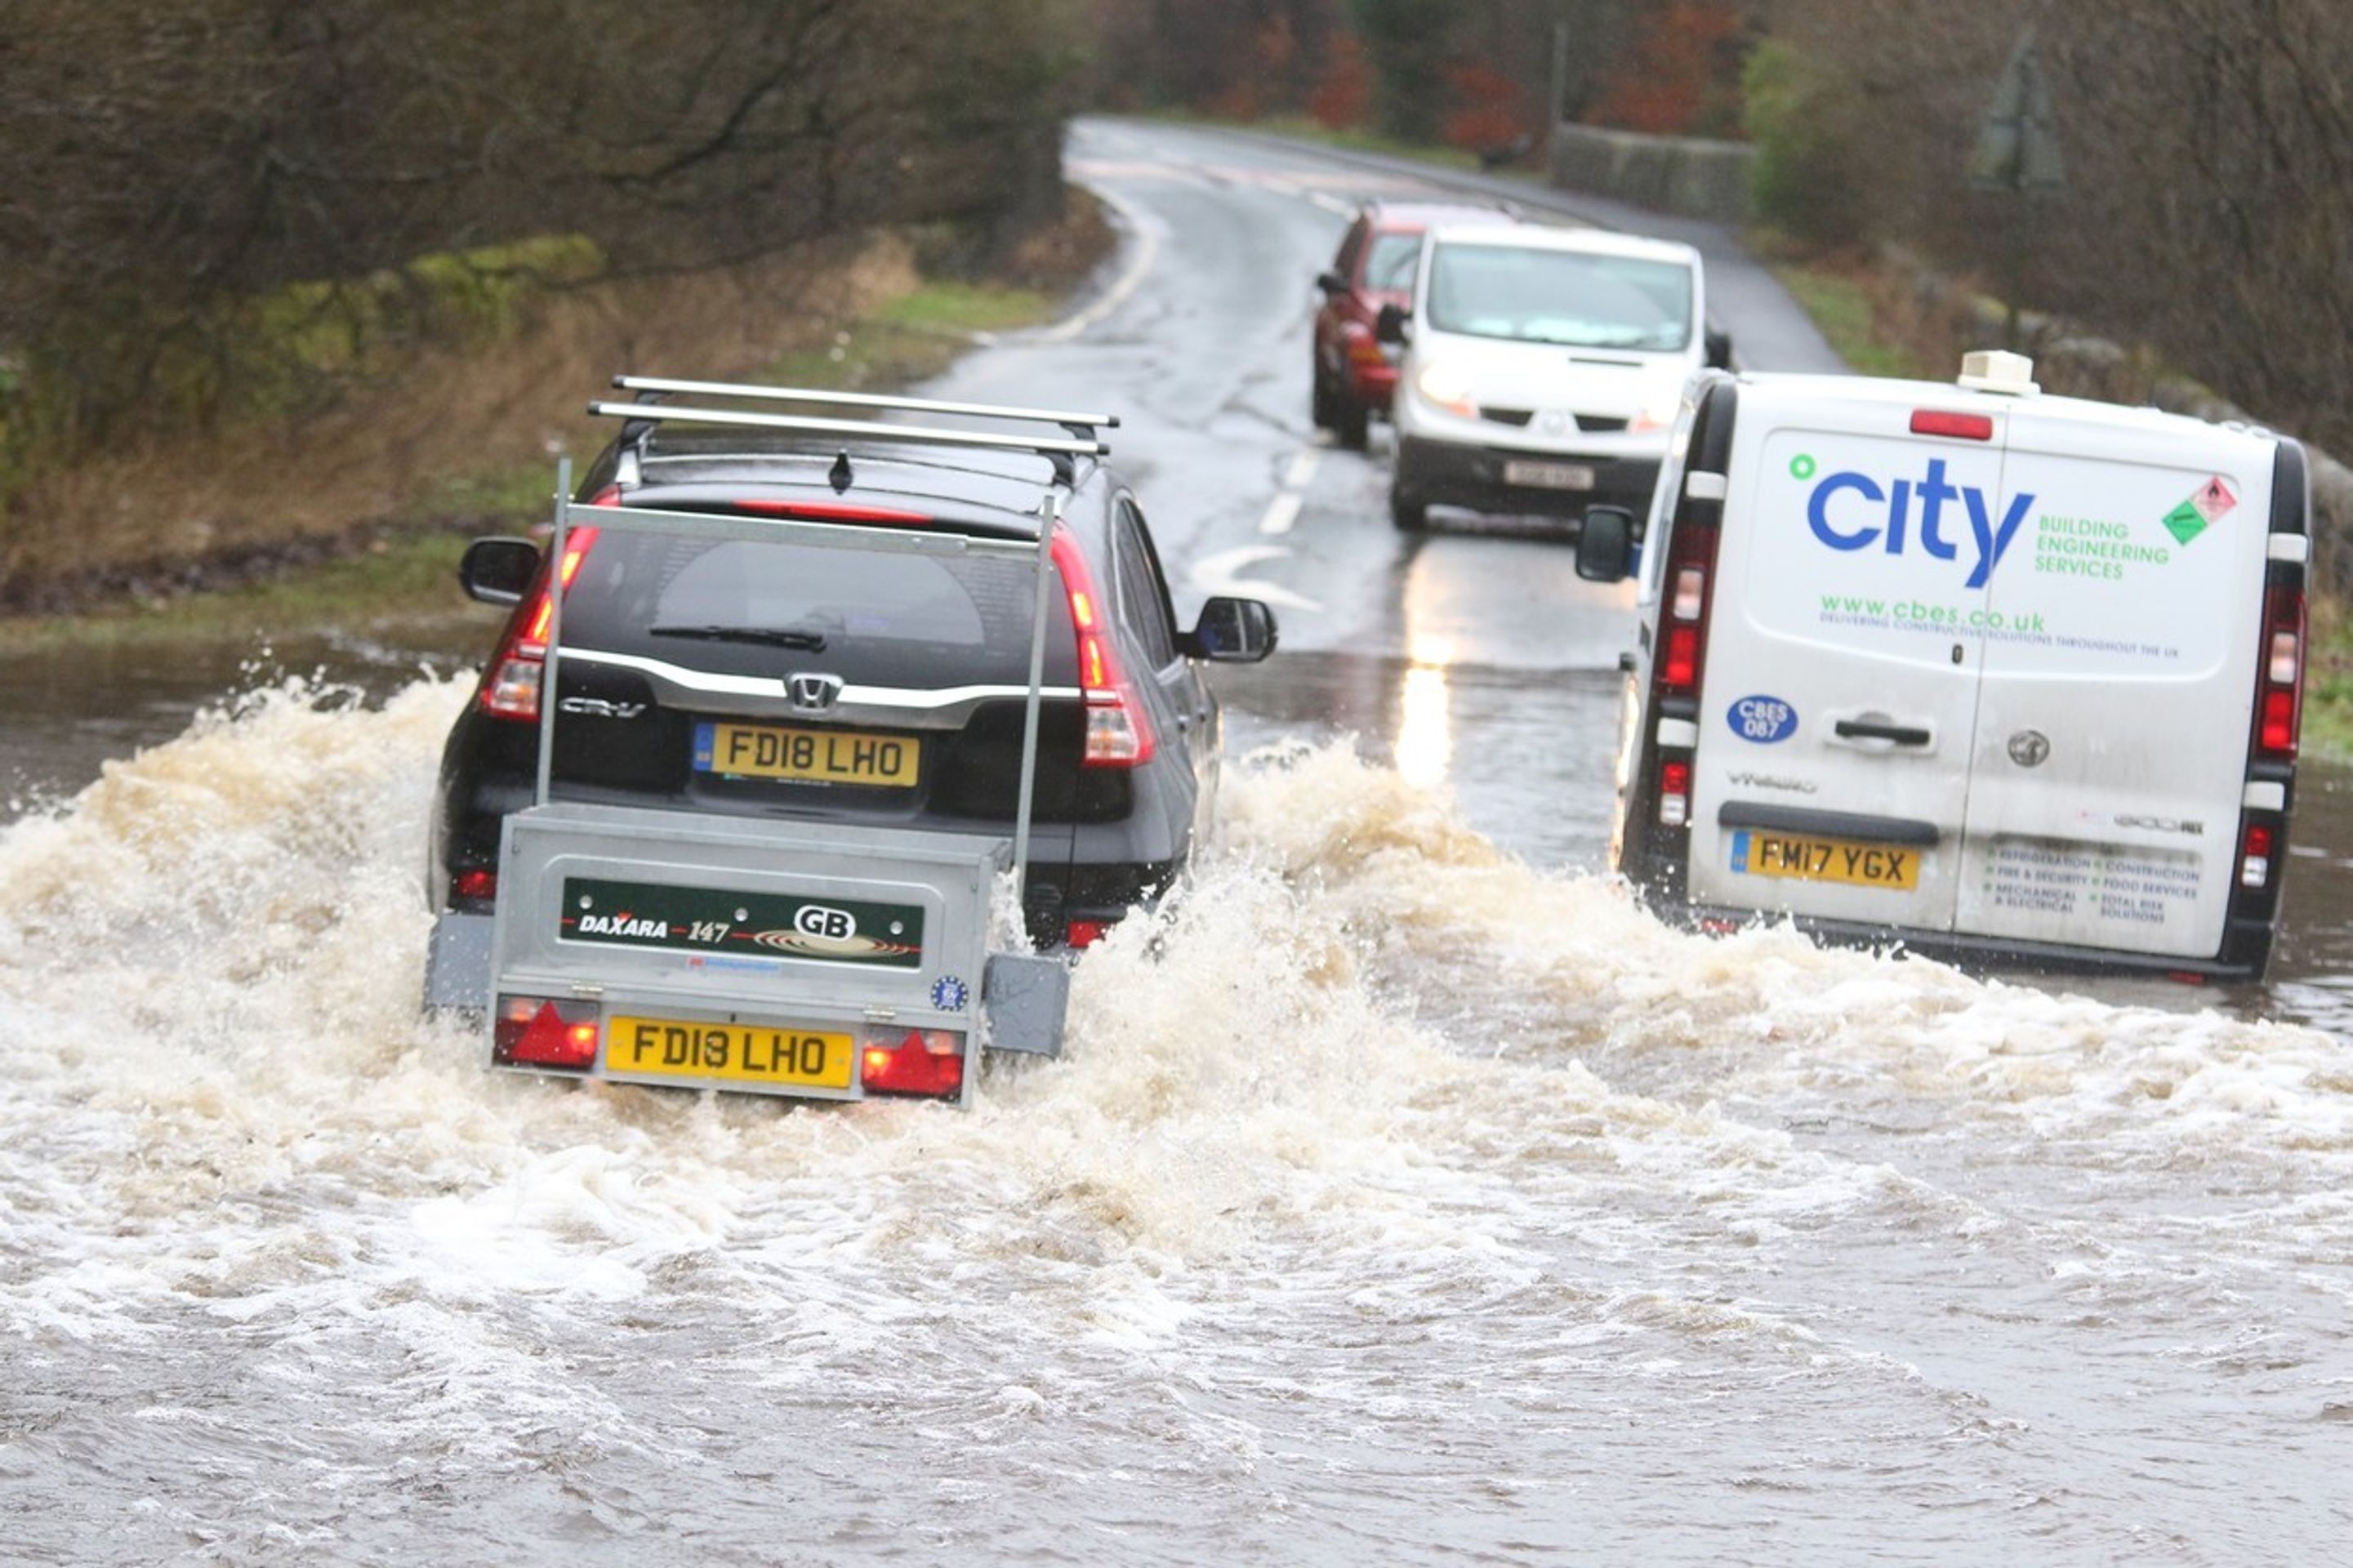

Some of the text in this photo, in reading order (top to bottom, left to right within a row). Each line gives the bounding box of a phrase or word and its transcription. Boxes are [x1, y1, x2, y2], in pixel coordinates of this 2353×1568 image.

[1807, 458, 2035, 589] city
[2039, 515, 2129, 540] BUILDING
[2037, 535, 2169, 565] ENGINEERING
[2034, 555, 2123, 579] SERVICES
[1821, 595, 2044, 632] www.cbes.co.uk
[1739, 701, 1788, 723] CBES
[1744, 719, 1780, 738] 087
[729, 731, 814, 770] FD18
[1760, 838, 1905, 882] FM17 YGX
[579, 913, 729, 943] DAXARA 147
[799, 908, 849, 938] GB
